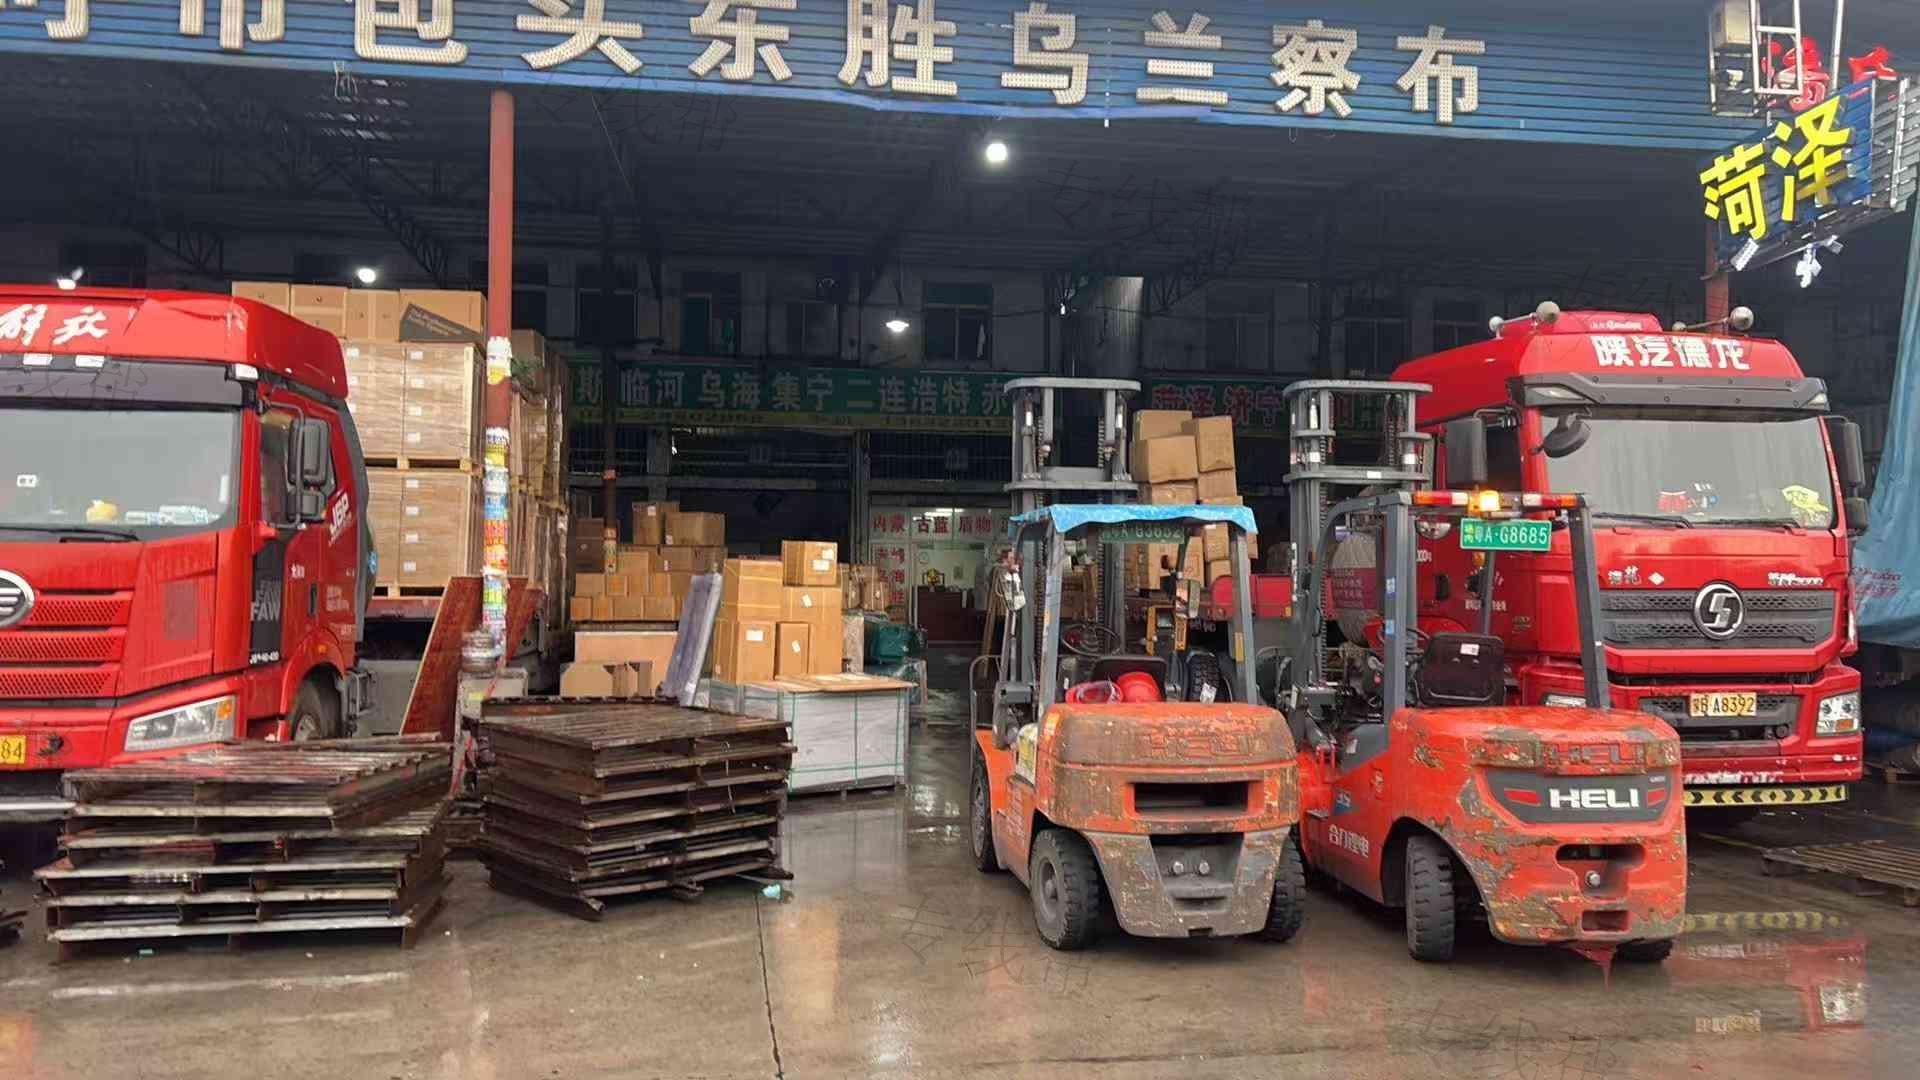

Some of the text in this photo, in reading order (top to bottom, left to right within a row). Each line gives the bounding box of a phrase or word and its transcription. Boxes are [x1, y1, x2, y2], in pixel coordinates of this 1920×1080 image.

[1700, 95, 1851, 241] 菏泽
[1590, 335, 1750, 371] 陕汽德龙
[621, 368, 686, 407] 临河
[697, 369, 762, 409] 乌海
[770, 369, 833, 412] 集宁
[846, 376, 970, 416] 二连浩特
[1549, 788, 1640, 808] HELI
